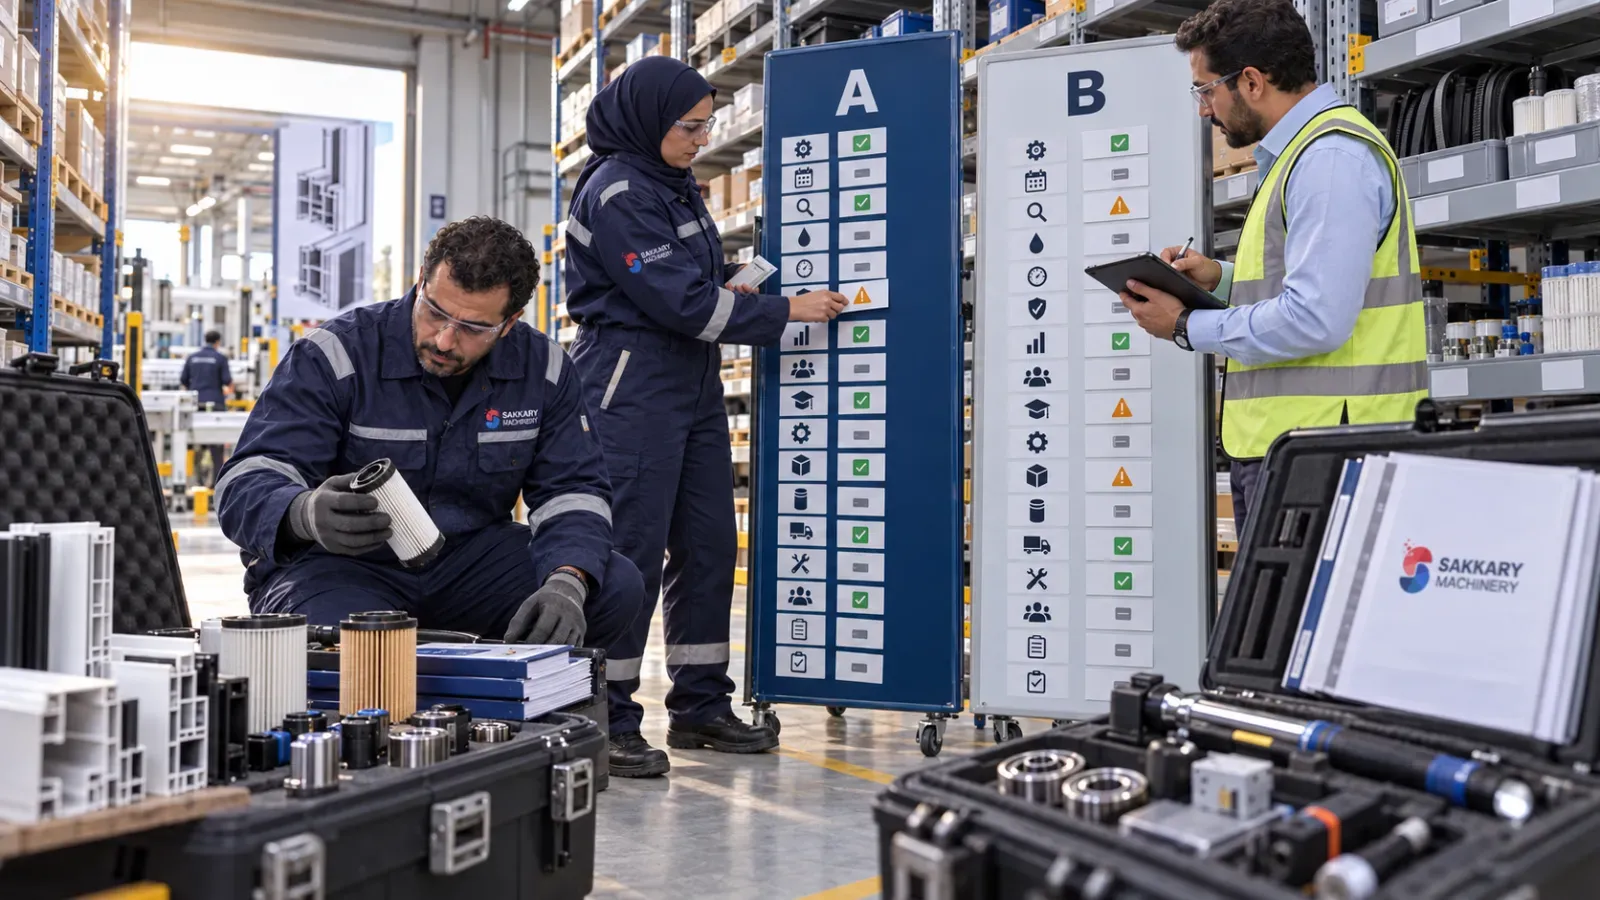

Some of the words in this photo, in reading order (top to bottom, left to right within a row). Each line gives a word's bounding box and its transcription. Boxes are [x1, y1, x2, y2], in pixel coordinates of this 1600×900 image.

[835, 68, 879, 117] A
[1067, 69, 1107, 117] B
[502, 409, 539, 419] SAKKARY
[1438, 557, 1524, 578] SAKKARY
[1435, 576, 1519, 594] MACHINERY
